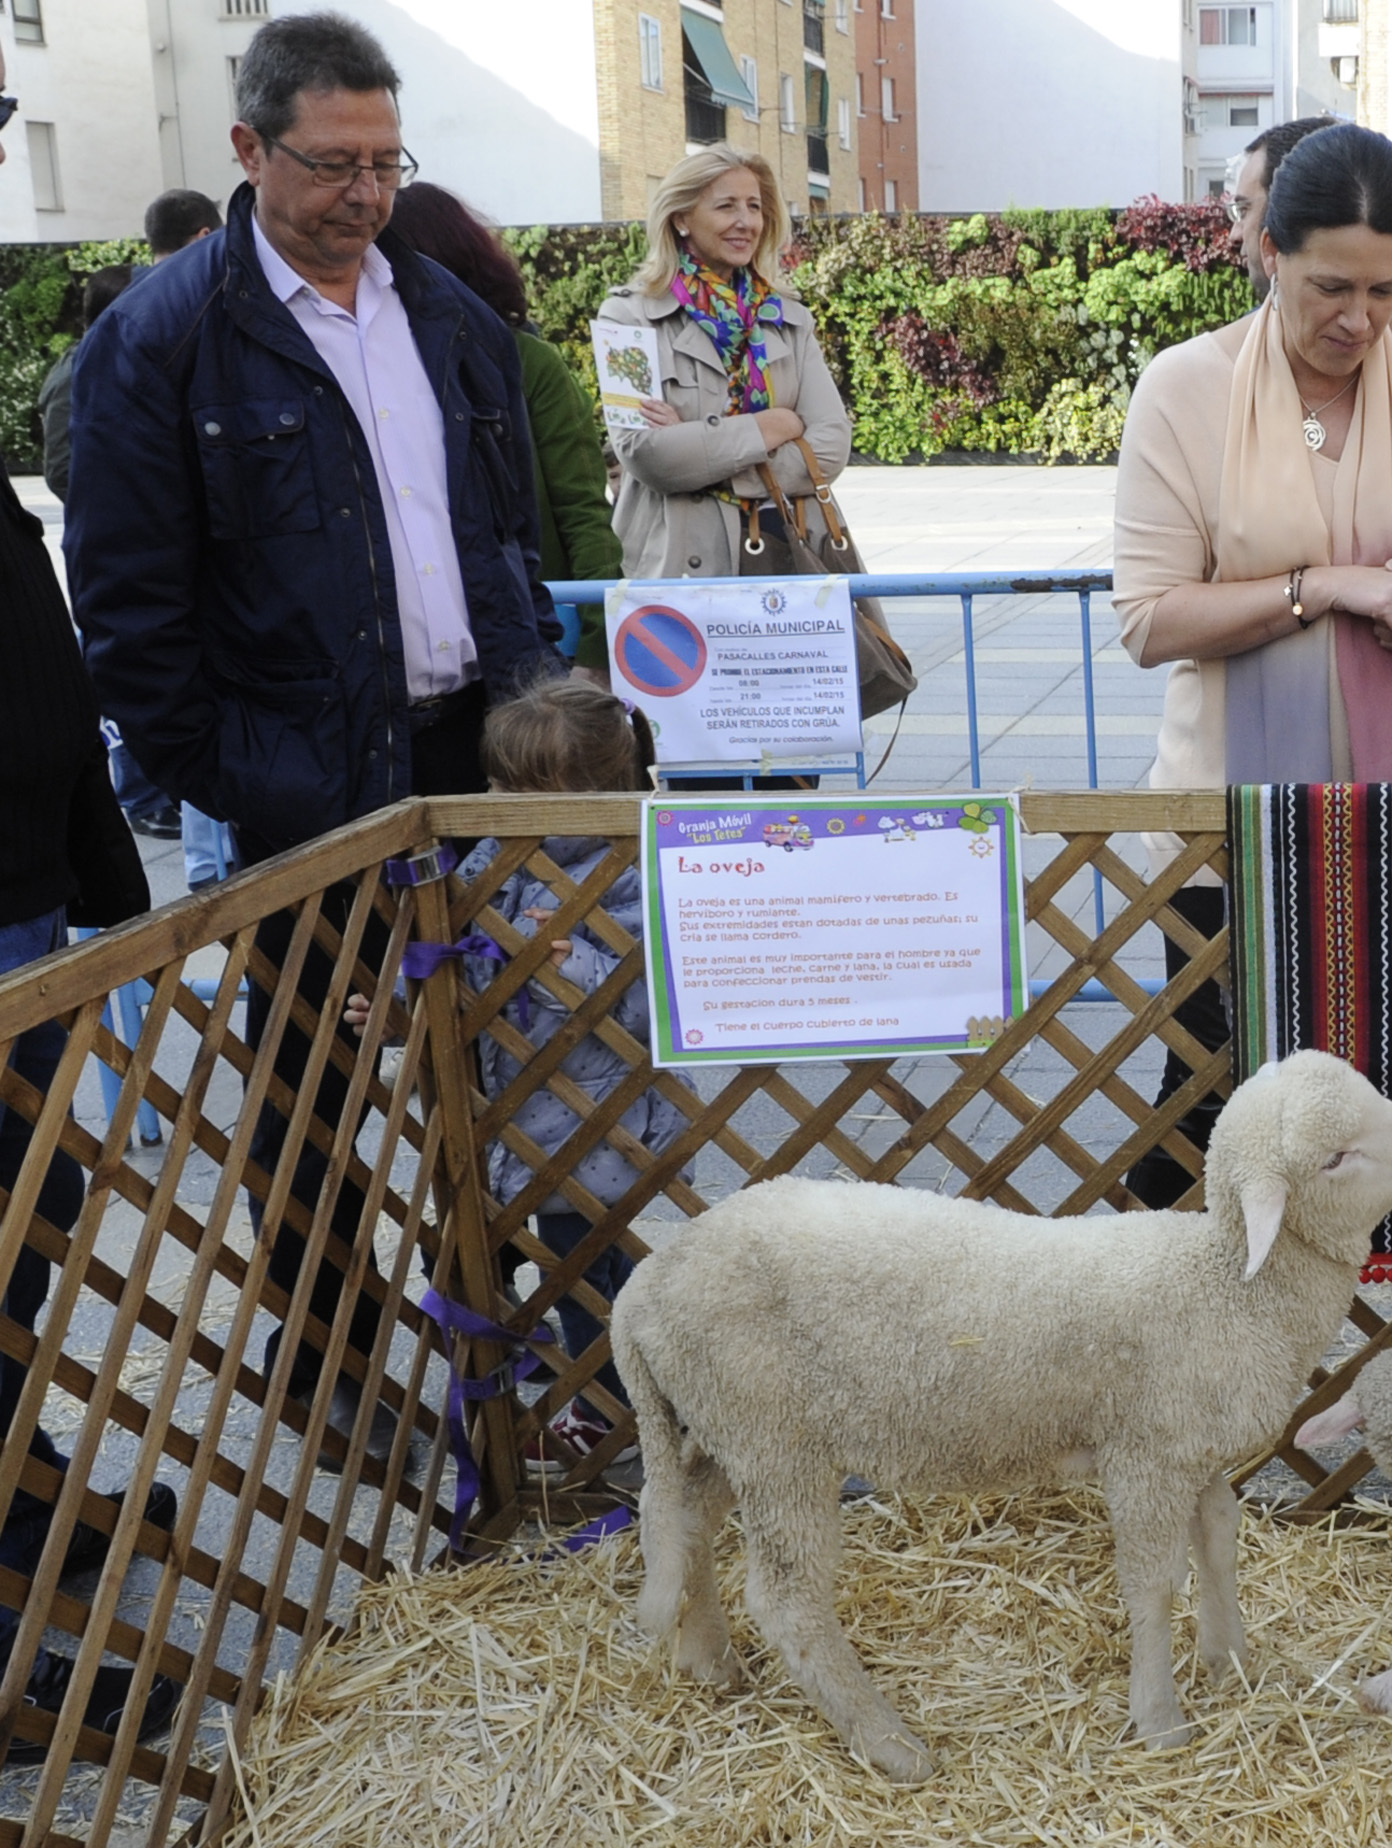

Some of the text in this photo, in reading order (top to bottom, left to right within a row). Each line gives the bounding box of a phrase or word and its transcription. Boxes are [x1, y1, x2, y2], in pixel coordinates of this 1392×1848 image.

[706, 619, 845, 635] POLICÍA MUNICIPAL
[717, 650, 829, 661] PASACALLES CARNAVAL
[700, 706, 845, 718] LOS VEHÍCULOS QUE INCUMPLAN
[706, 718, 738, 730] SERÁN
[740, 719, 789, 729] RETIRADOS
[791, 719, 811, 728] CON
[678, 812, 752, 834] Granja Móvil
[678, 855, 765, 877] La oveja
[678, 897, 693, 908] La
[696, 897, 726, 907] oveja
[729, 898, 741, 906] es
[744, 897, 765, 906] una
[768, 896, 804, 906] animal
[873, 892, 941, 902] vertebrado.
[944, 891, 959, 902] Es
[746, 908, 801, 918] rumiante.
[679, 921, 699, 931] Sus
[702, 919, 779, 930] extremidades
[816, 917, 862, 927] dotadas
[865, 916, 880, 926] de
[883, 916, 909, 925] unas
[965, 914, 979, 923] su
[705, 934, 717, 942] se
[720, 932, 749, 942] llama
[682, 948, 981, 966] Este animal es muy importante para el hombre ya que
[683, 968, 693, 977] le
[696, 966, 765, 977] proporciona
[883, 961, 893, 970] la
[923, 960, 936, 968] es
[939, 958, 972, 968] usada
[684, 979, 709, 988] para
[712, 976, 788, 988] confeccionar
[791, 974, 835, 985] prendas
[839, 973, 853, 982] de
[703, 1001, 718, 1011] Su
[778, 997, 805, 1007] dura
[818, 996, 851, 1006] meses
[715, 1022, 747, 1033] Tiene
[750, 1022, 760, 1031] el
[859, 1017, 873, 1026] de
[876, 1016, 900, 1026] lana
